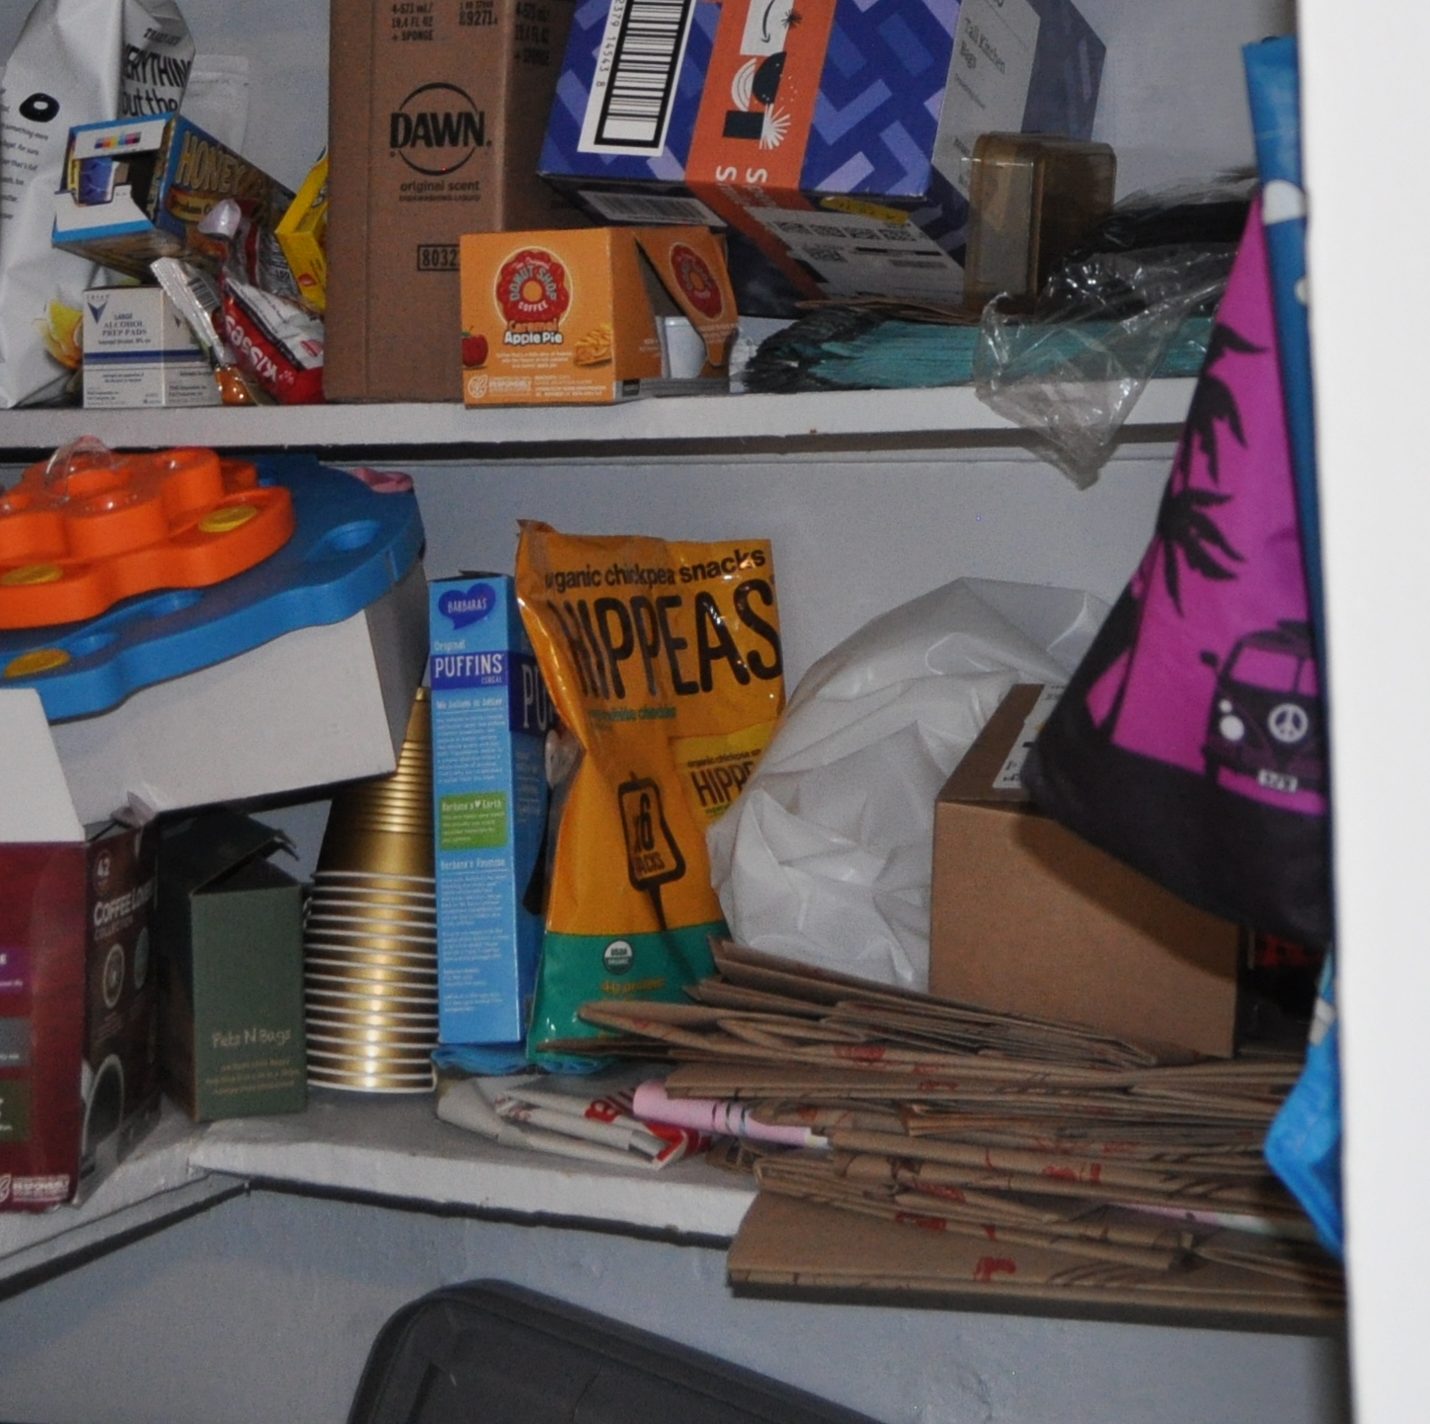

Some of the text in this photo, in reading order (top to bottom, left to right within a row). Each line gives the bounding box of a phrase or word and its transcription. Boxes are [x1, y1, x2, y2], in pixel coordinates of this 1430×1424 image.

[400, 30, 434, 42] SPONGE
[389, 111, 486, 149] DAWN
[175, 129, 247, 196] HONEY
[399, 179, 481, 193] original scent
[421, 248, 460, 268] 8032
[509, 265, 558, 302] DONUT SHOP
[517, 299, 550, 313] COFFEE
[104, 320, 143, 329] ALCOHOL
[114, 312, 134, 321] LARGE
[102, 328, 148, 337] PREP PADS
[504, 331, 564, 345] Apple Pie
[604, 562, 675, 588] chickpea
[677, 547, 766, 584] snacks
[434, 639, 467, 653] Original
[434, 654, 503, 679] PUFFINS
[690, 760, 753, 809] HIPP
[93, 891, 132, 928] COFFEE
